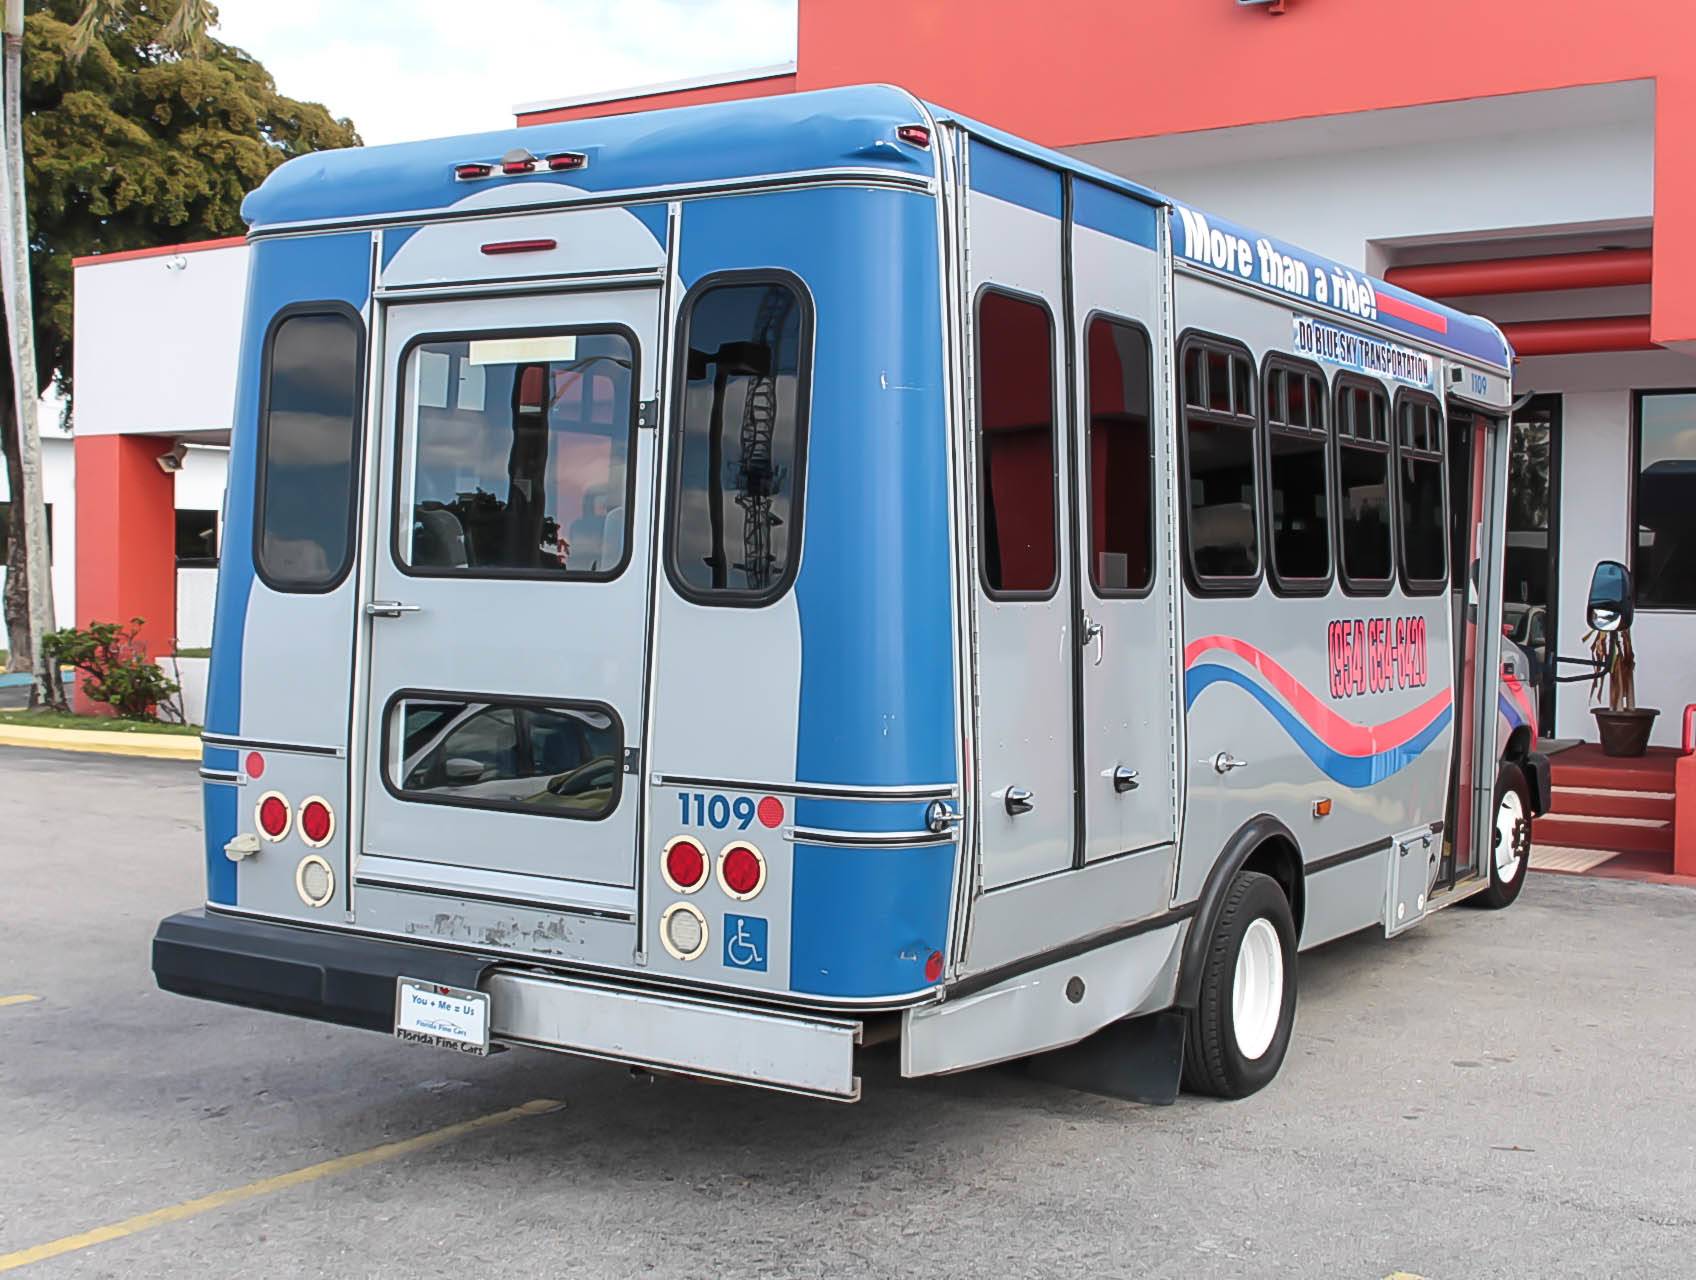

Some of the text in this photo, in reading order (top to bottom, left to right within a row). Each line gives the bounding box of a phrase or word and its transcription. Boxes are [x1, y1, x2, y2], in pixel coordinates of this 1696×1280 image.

[1177, 205, 1377, 320] More than a ride!
[1299, 321, 1428, 384] DO BLUE SKY TRANSPORTATION
[1471, 373, 1487, 395] 1109
[1328, 619, 1366, 699] (954)
[678, 792, 756, 830] 1109
[412, 995, 428, 1006] You
[439, 1000, 451, 1011] Me
[463, 1005, 475, 1016] Us
[397, 1028, 484, 1056] Florida Fine Cars
[416, 1020, 437, 1030] Florida
[438, 1024, 452, 1033] Fine
